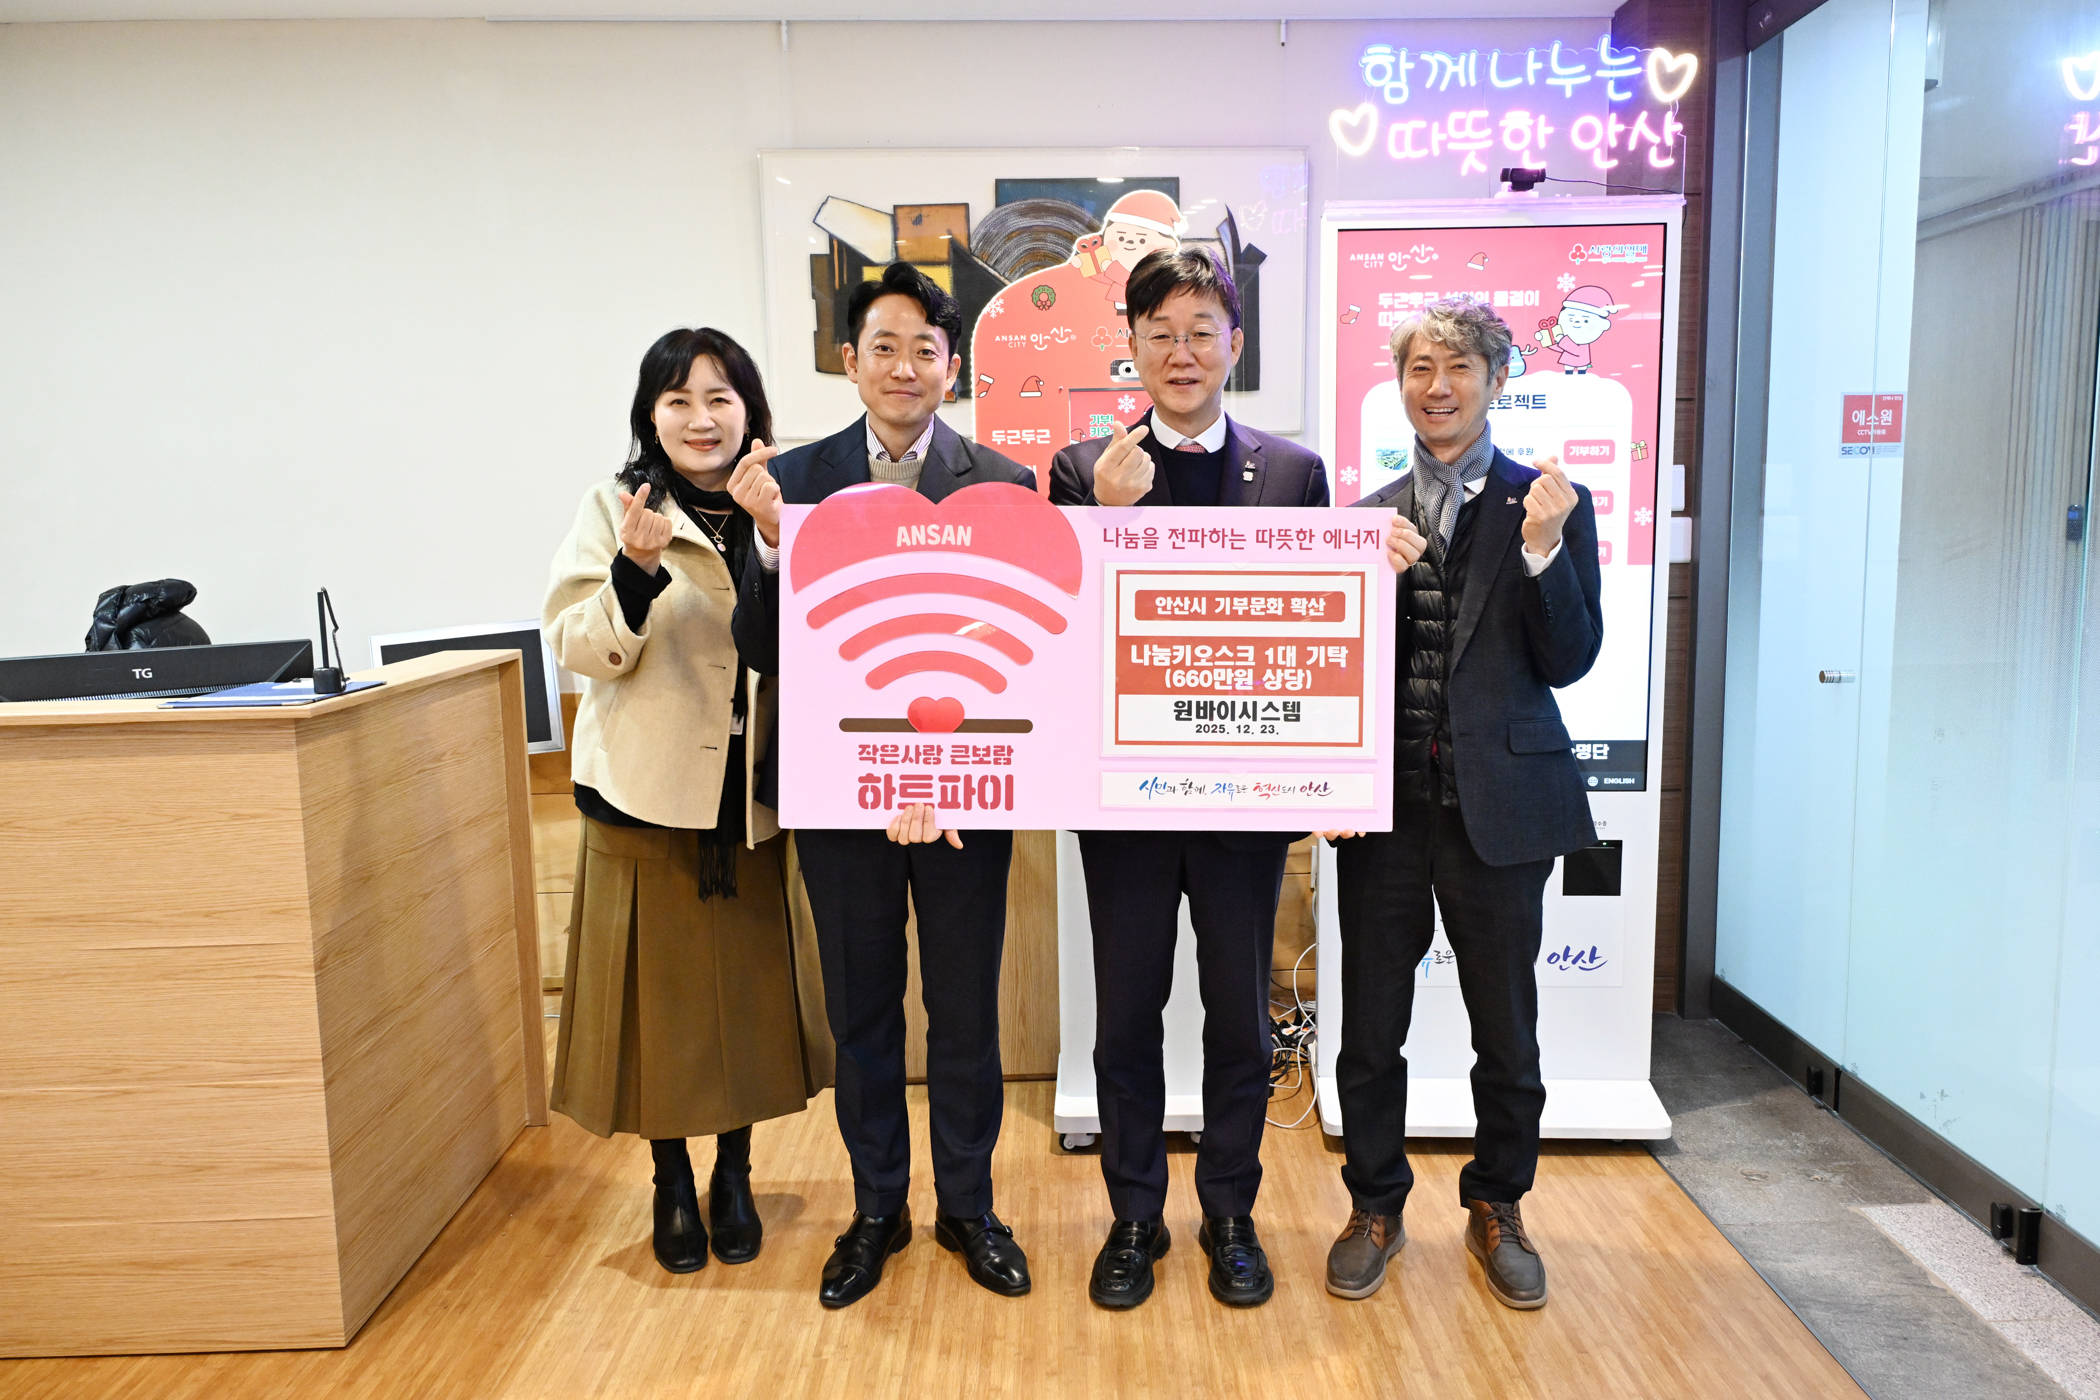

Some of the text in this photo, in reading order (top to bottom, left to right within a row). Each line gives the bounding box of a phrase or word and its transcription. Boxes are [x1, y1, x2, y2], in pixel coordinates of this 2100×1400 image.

[1361, 35, 1642, 104] 함께 나누는
[1388, 110, 1684, 176] 따뜻한 안산
[1349, 253, 1385, 261] ANSAN
[994, 334, 1027, 342] ANSAN
[1489, 394, 1547, 410] 로젝트
[1851, 409, 1893, 426] 에스원
[991, 429, 1051, 445] 두근두근
[1089, 426, 1116, 438] 키오
[1569, 445, 1610, 457] 기부하기
[896, 524, 972, 547] ANSAN
[1103, 527, 1380, 551] 나눔을 전파하는 따뜻한 에너지
[1154, 596, 1326, 617] 안산시 기부문화 확산
[1130, 644, 1349, 668] 나눔키오스크 1대 기탁
[131, 667, 153, 679] TG
[1164, 668, 1313, 691] (660만원 상당)
[1173, 700, 1301, 723] 원바이시스템
[1195, 724, 1280, 736] 2025. 12. 23.
[857, 743, 1014, 766] 작은사랑 큰보람
[1571, 743, 1610, 760] 명단
[857, 772, 1014, 811] 하트파이
[1138, 776, 1179, 801] 시민과
[1211, 782, 1249, 802] 자유로운
[1252, 781, 1296, 801] 혁신도시
[1299, 780, 1335, 797] 안산
[1603, 777, 1636, 785] ENGLISH
[1547, 945, 1608, 972] 안산
